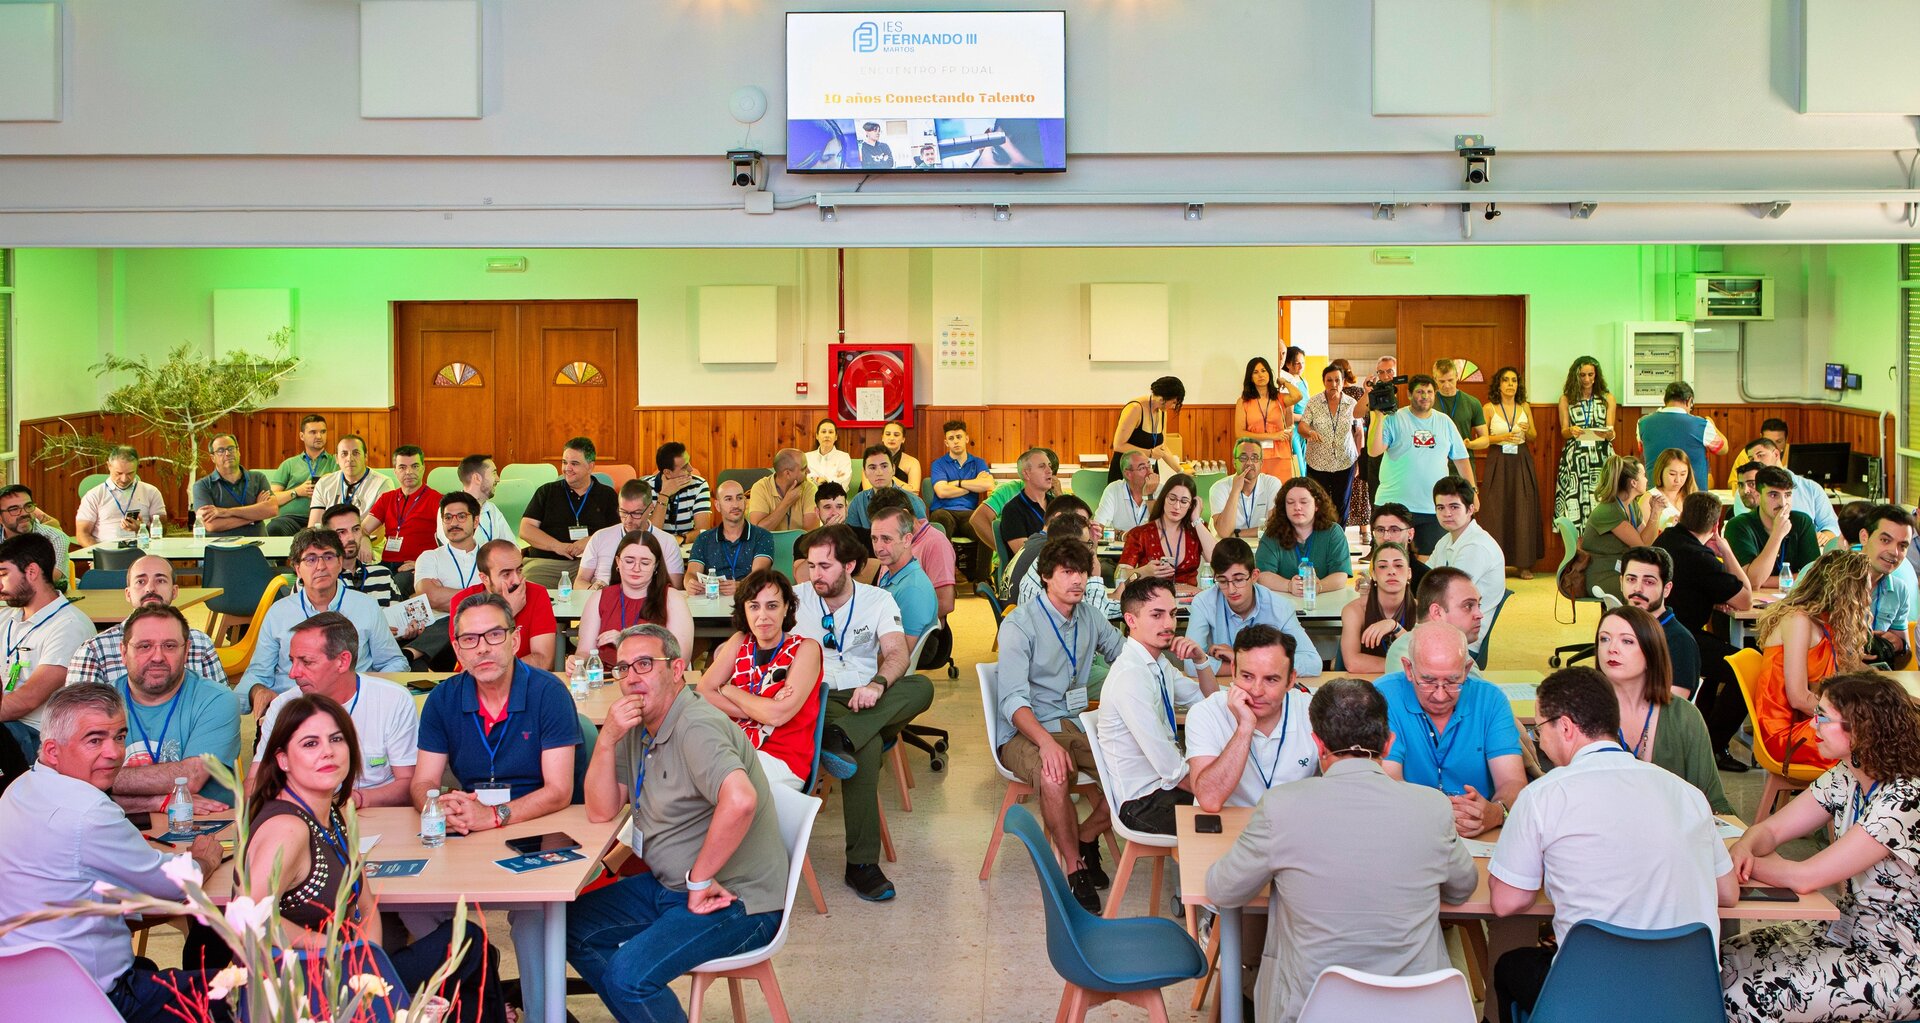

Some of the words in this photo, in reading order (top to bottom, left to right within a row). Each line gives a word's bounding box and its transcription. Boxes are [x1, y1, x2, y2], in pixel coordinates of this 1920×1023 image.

[883, 21, 903, 33] IES
[883, 33, 962, 45] FERNANDO
[966, 33, 977, 45] III
[860, 65, 936, 75] ENCUENTRO
[962, 65, 994, 75] DUAL
[824, 93, 842, 104] 10
[845, 91, 881, 104] años
[885, 92, 975, 104] Conectando
[979, 92, 1036, 103] Talento
